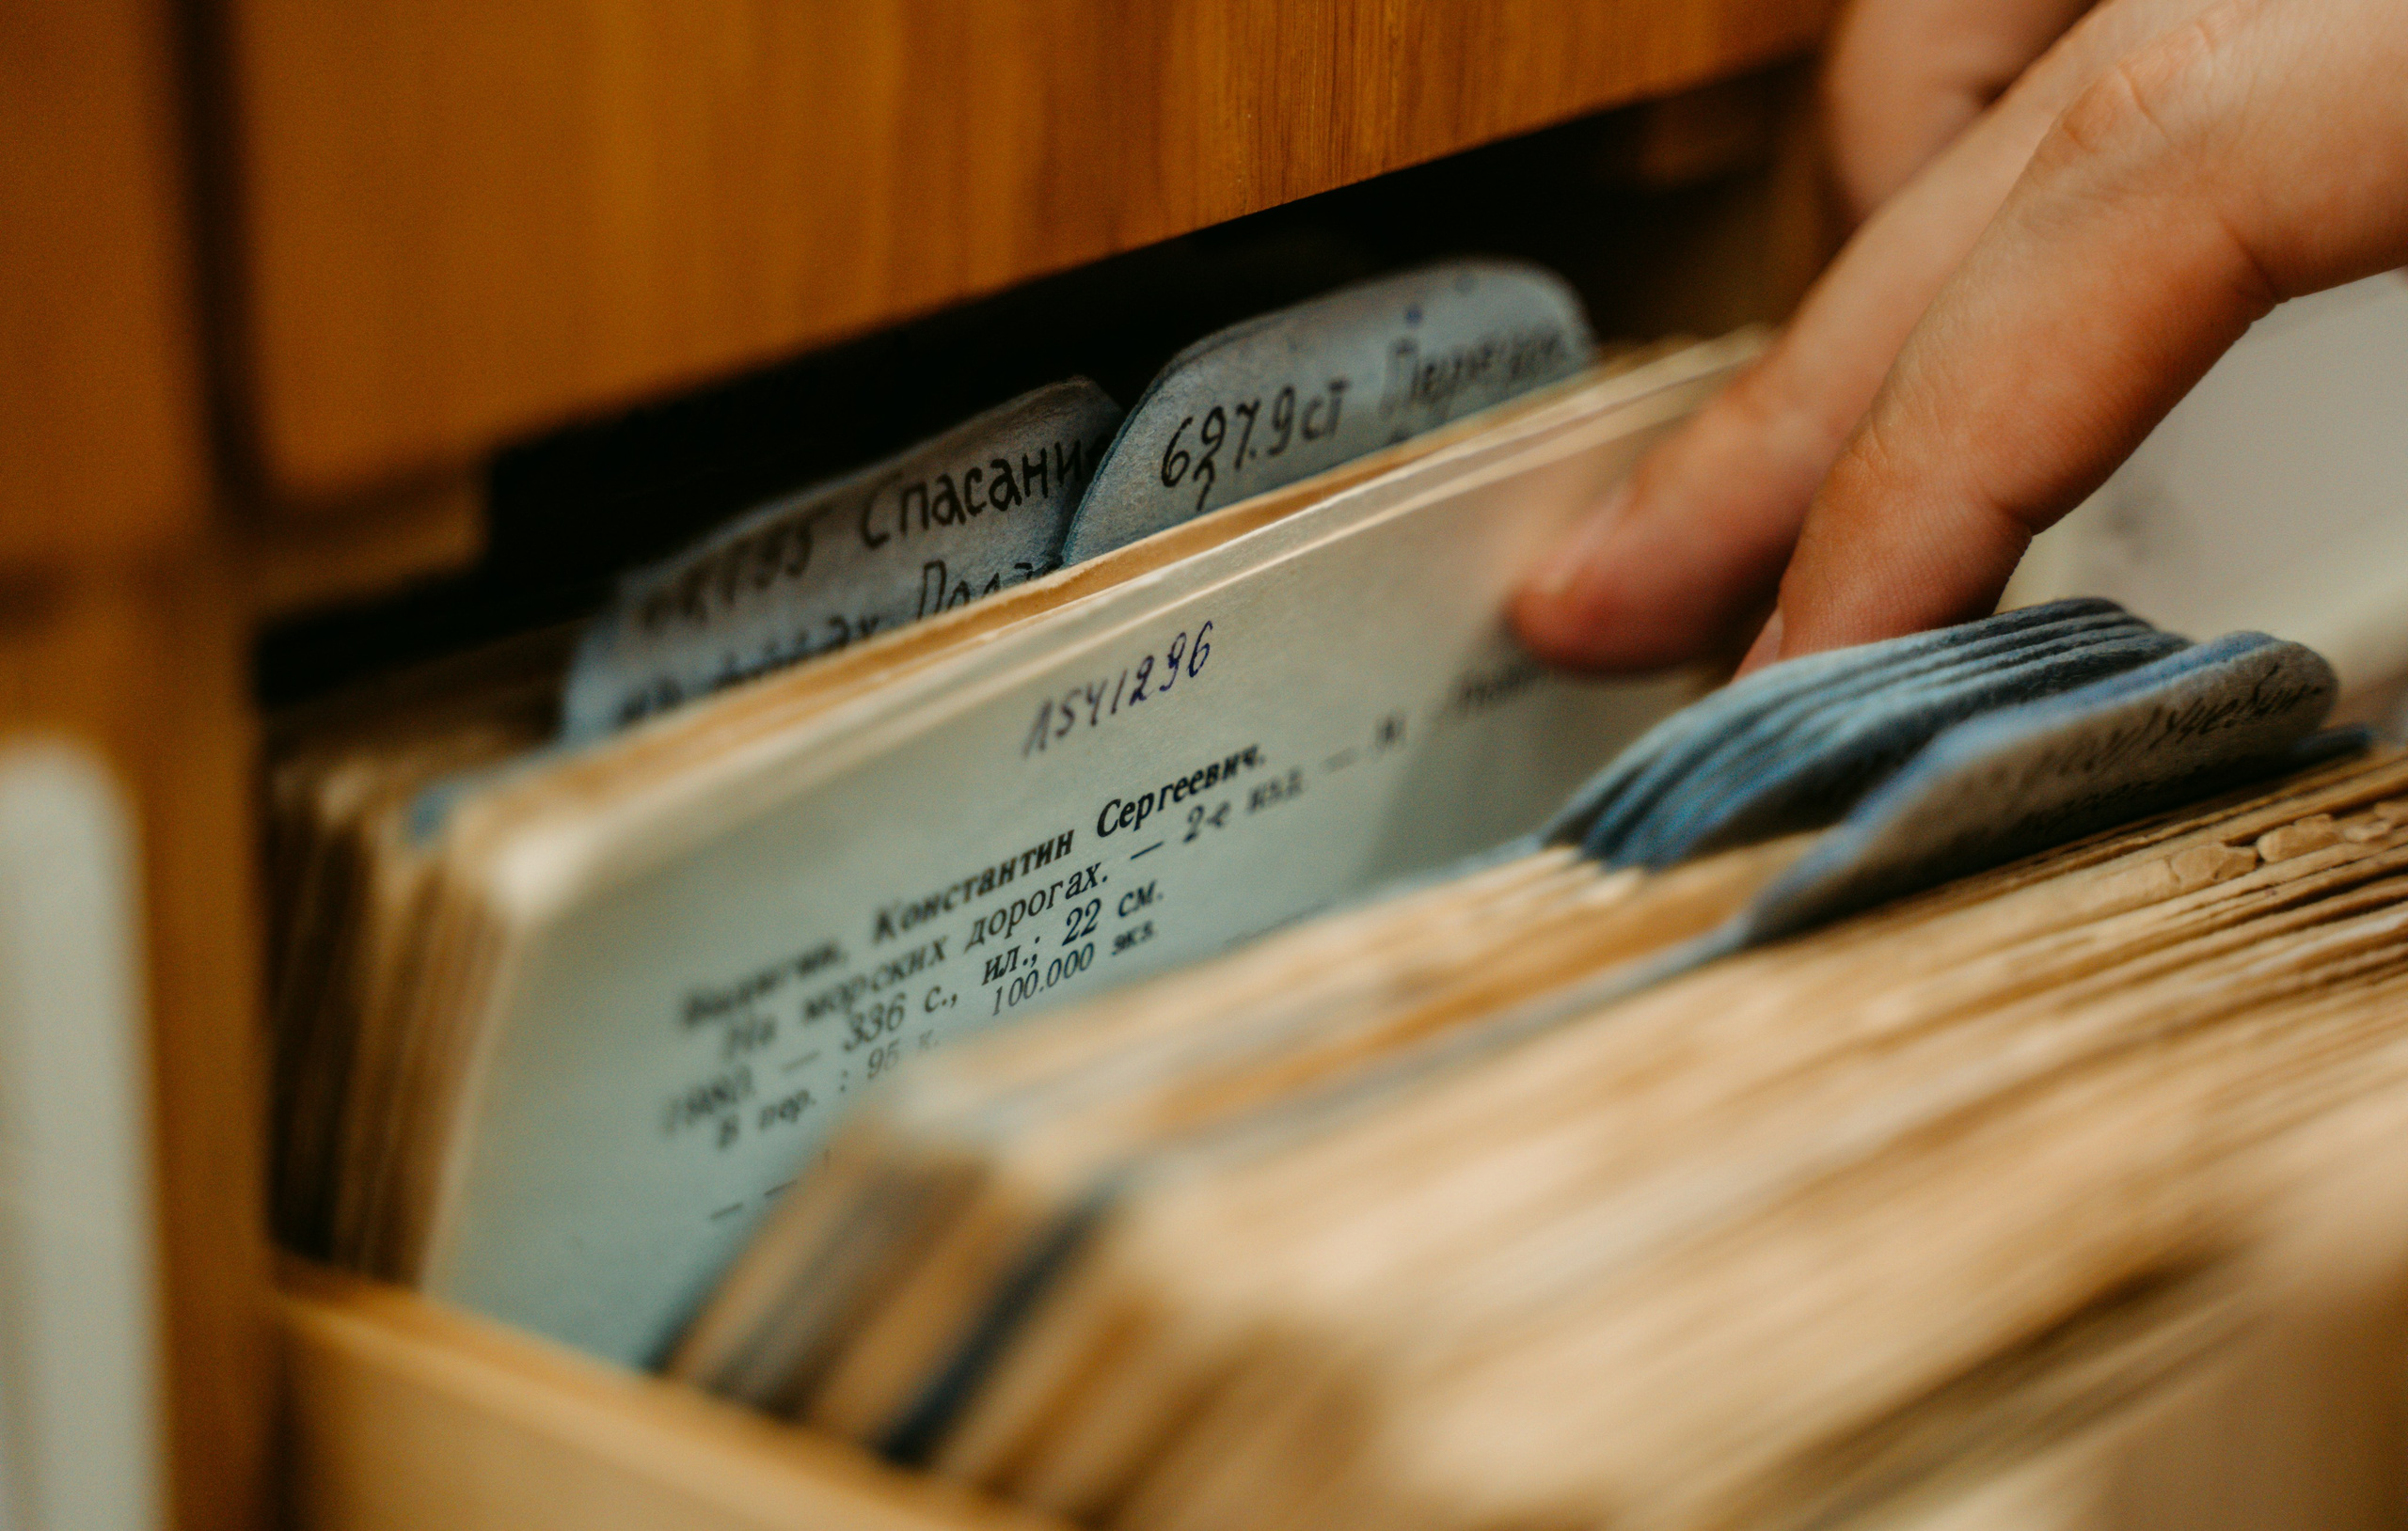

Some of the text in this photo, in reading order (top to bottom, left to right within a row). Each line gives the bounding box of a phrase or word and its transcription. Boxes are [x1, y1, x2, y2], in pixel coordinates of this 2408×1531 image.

[872, 829, 1075, 944] Константин
[961, 862, 1108, 954] дорогах.
[845, 992, 907, 1052] 336
[1062, 898, 1102, 946] 22
[1117, 880, 1164, 918] см.
[992, 942, 1097, 1016] 100.000
